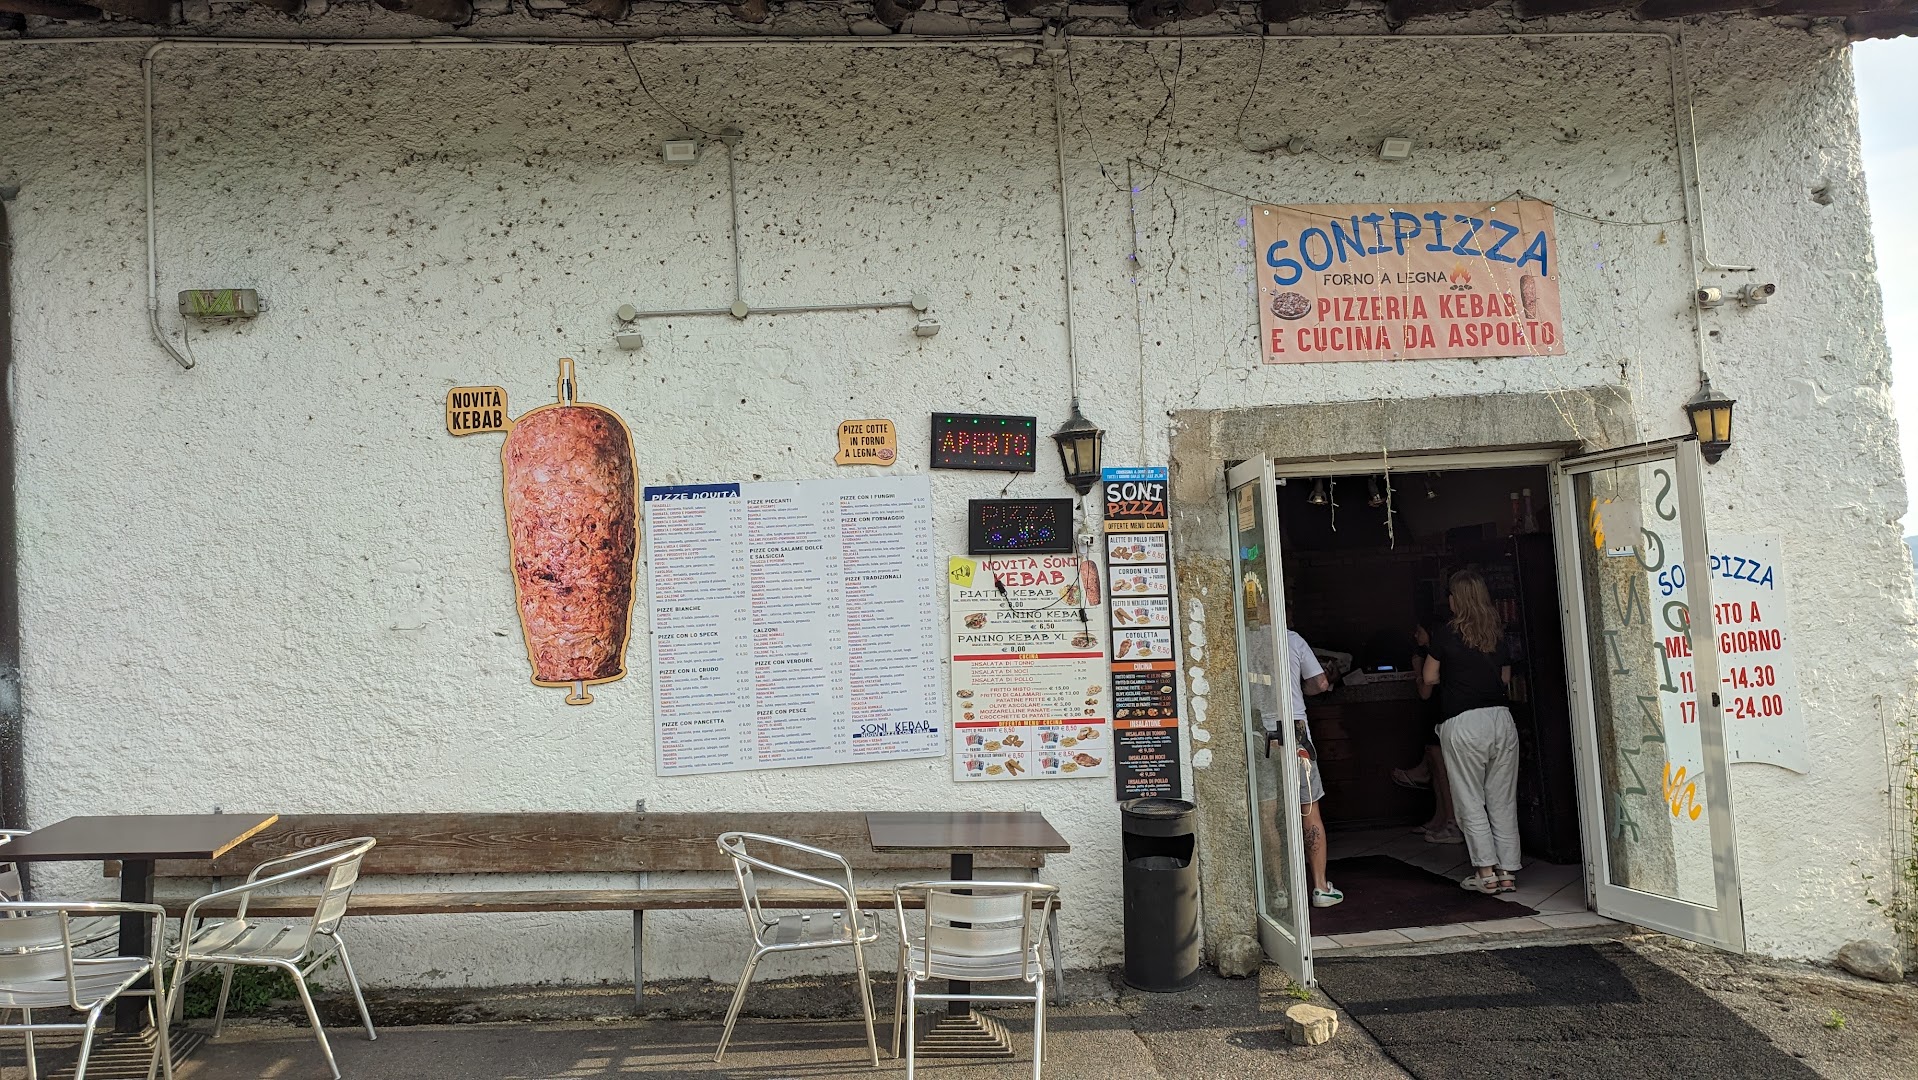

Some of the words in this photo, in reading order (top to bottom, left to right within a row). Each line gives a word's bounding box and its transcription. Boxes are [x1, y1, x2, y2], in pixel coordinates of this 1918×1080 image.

[1266, 210, 1549, 286] SONIPIZZA
[1323, 273, 1374, 286] FORNO
[1380, 274, 1391, 285] A
[1397, 271, 1447, 284] LEGNA
[1317, 294, 1428, 322] PIZZERIA
[1439, 293, 1518, 319] KEBAB
[1271, 328, 1285, 353] E
[1297, 325, 1391, 352] CUCINA
[1406, 324, 1436, 349] DA
[1447, 321, 1555, 348] ASPORTO
[453, 388, 501, 408] NOVITÀ
[453, 410, 502, 430] KEBAB
[843, 424, 863, 434] PIZZE
[866, 424, 888, 434] COTTE
[850, 436, 858, 446] IN
[861, 436, 885, 446] FORNO
[943, 431, 1027, 455] APERTO
[845, 448, 850, 458] A
[652, 493, 689, 501] PIZZE
[1107, 482, 1164, 502] SONI
[982, 506, 1056, 525] PIZZA
[1107, 500, 1164, 518] PIZZA
[1108, 522, 1129, 530] OFFERTE
[982, 557, 1038, 571] NOVITÀ
[1043, 557, 1078, 569] SONI
[994, 570, 1065, 587] KEBAB
[1013, 589, 1054, 597] KEBAB
[997, 611, 1042, 619] PANINO
[1047, 610, 1080, 618] KEBA
[1750, 601, 1761, 622] A
[957, 634, 1003, 643] PANINO
[1125, 631, 1158, 639] COTOLETTA
[861, 722, 887, 734] SONI
[895, 720, 930, 731] KEBAB
[1129, 720, 1162, 728] INSALATONE
